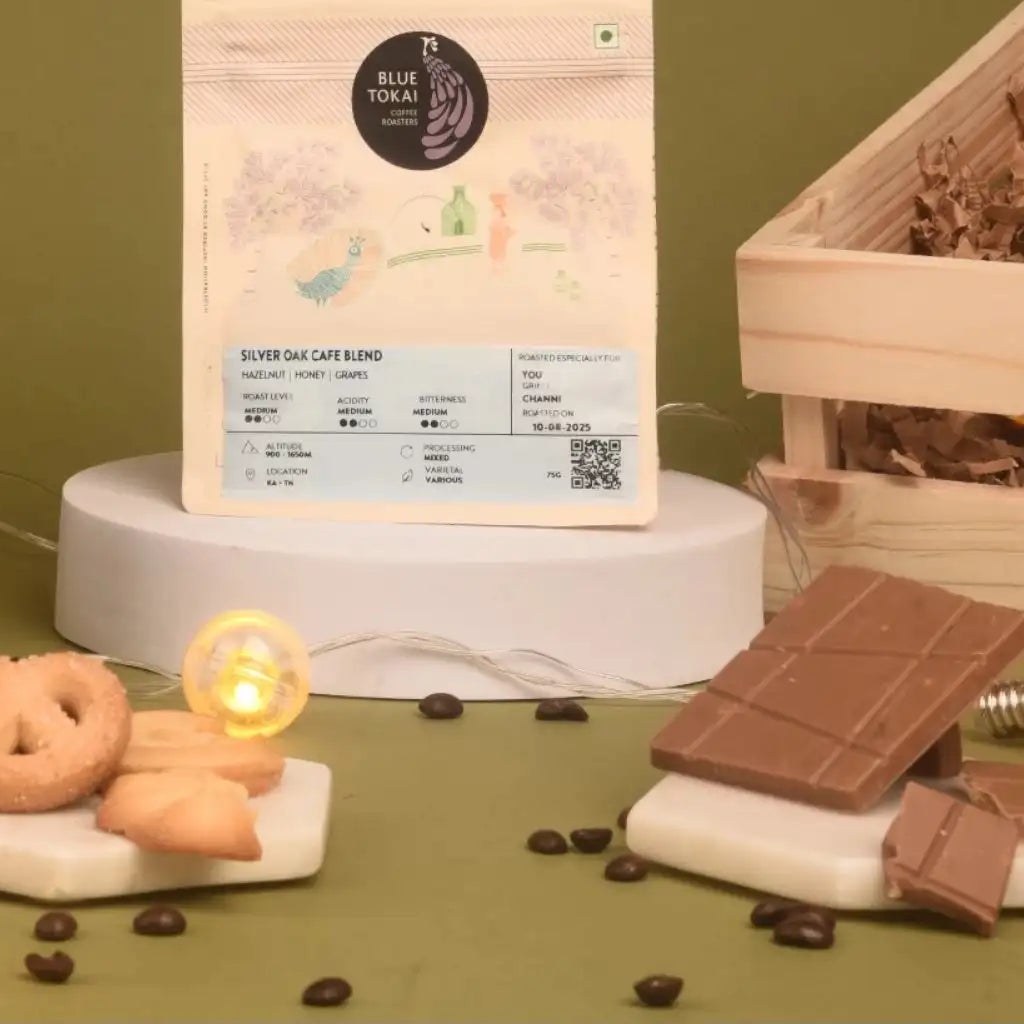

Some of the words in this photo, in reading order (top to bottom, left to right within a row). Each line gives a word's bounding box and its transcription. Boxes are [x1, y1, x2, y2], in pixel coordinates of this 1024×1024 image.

[378, 71, 418, 85] BLUE
[367, 89, 418, 103] TOKAI
[390, 109, 418, 117] COFFEE
[382, 118, 418, 126] ROASTERS
[241, 349, 280, 362] SILVER
[283, 349, 308, 362] OAK
[311, 349, 341, 362] CAFE
[344, 349, 383, 362] BLEND
[242, 370, 286, 380] HAZELNUT
[295, 370, 326, 380] HONEY
[335, 370, 368, 380] GRAPES
[522, 370, 543, 379] YOU
[242, 392, 268, 401] ROAST
[418, 395, 466, 404] BITTERNESS
[522, 394, 562, 403] CHANNI
[337, 397, 369, 405] ACIDITY
[244, 407, 278, 415] MEDIUM
[337, 407, 373, 415] MEDIUM
[413, 408, 448, 416] MEDIUM
[266, 468, 308, 476] LOCATION
[425, 476, 463, 484] VARIOUS
